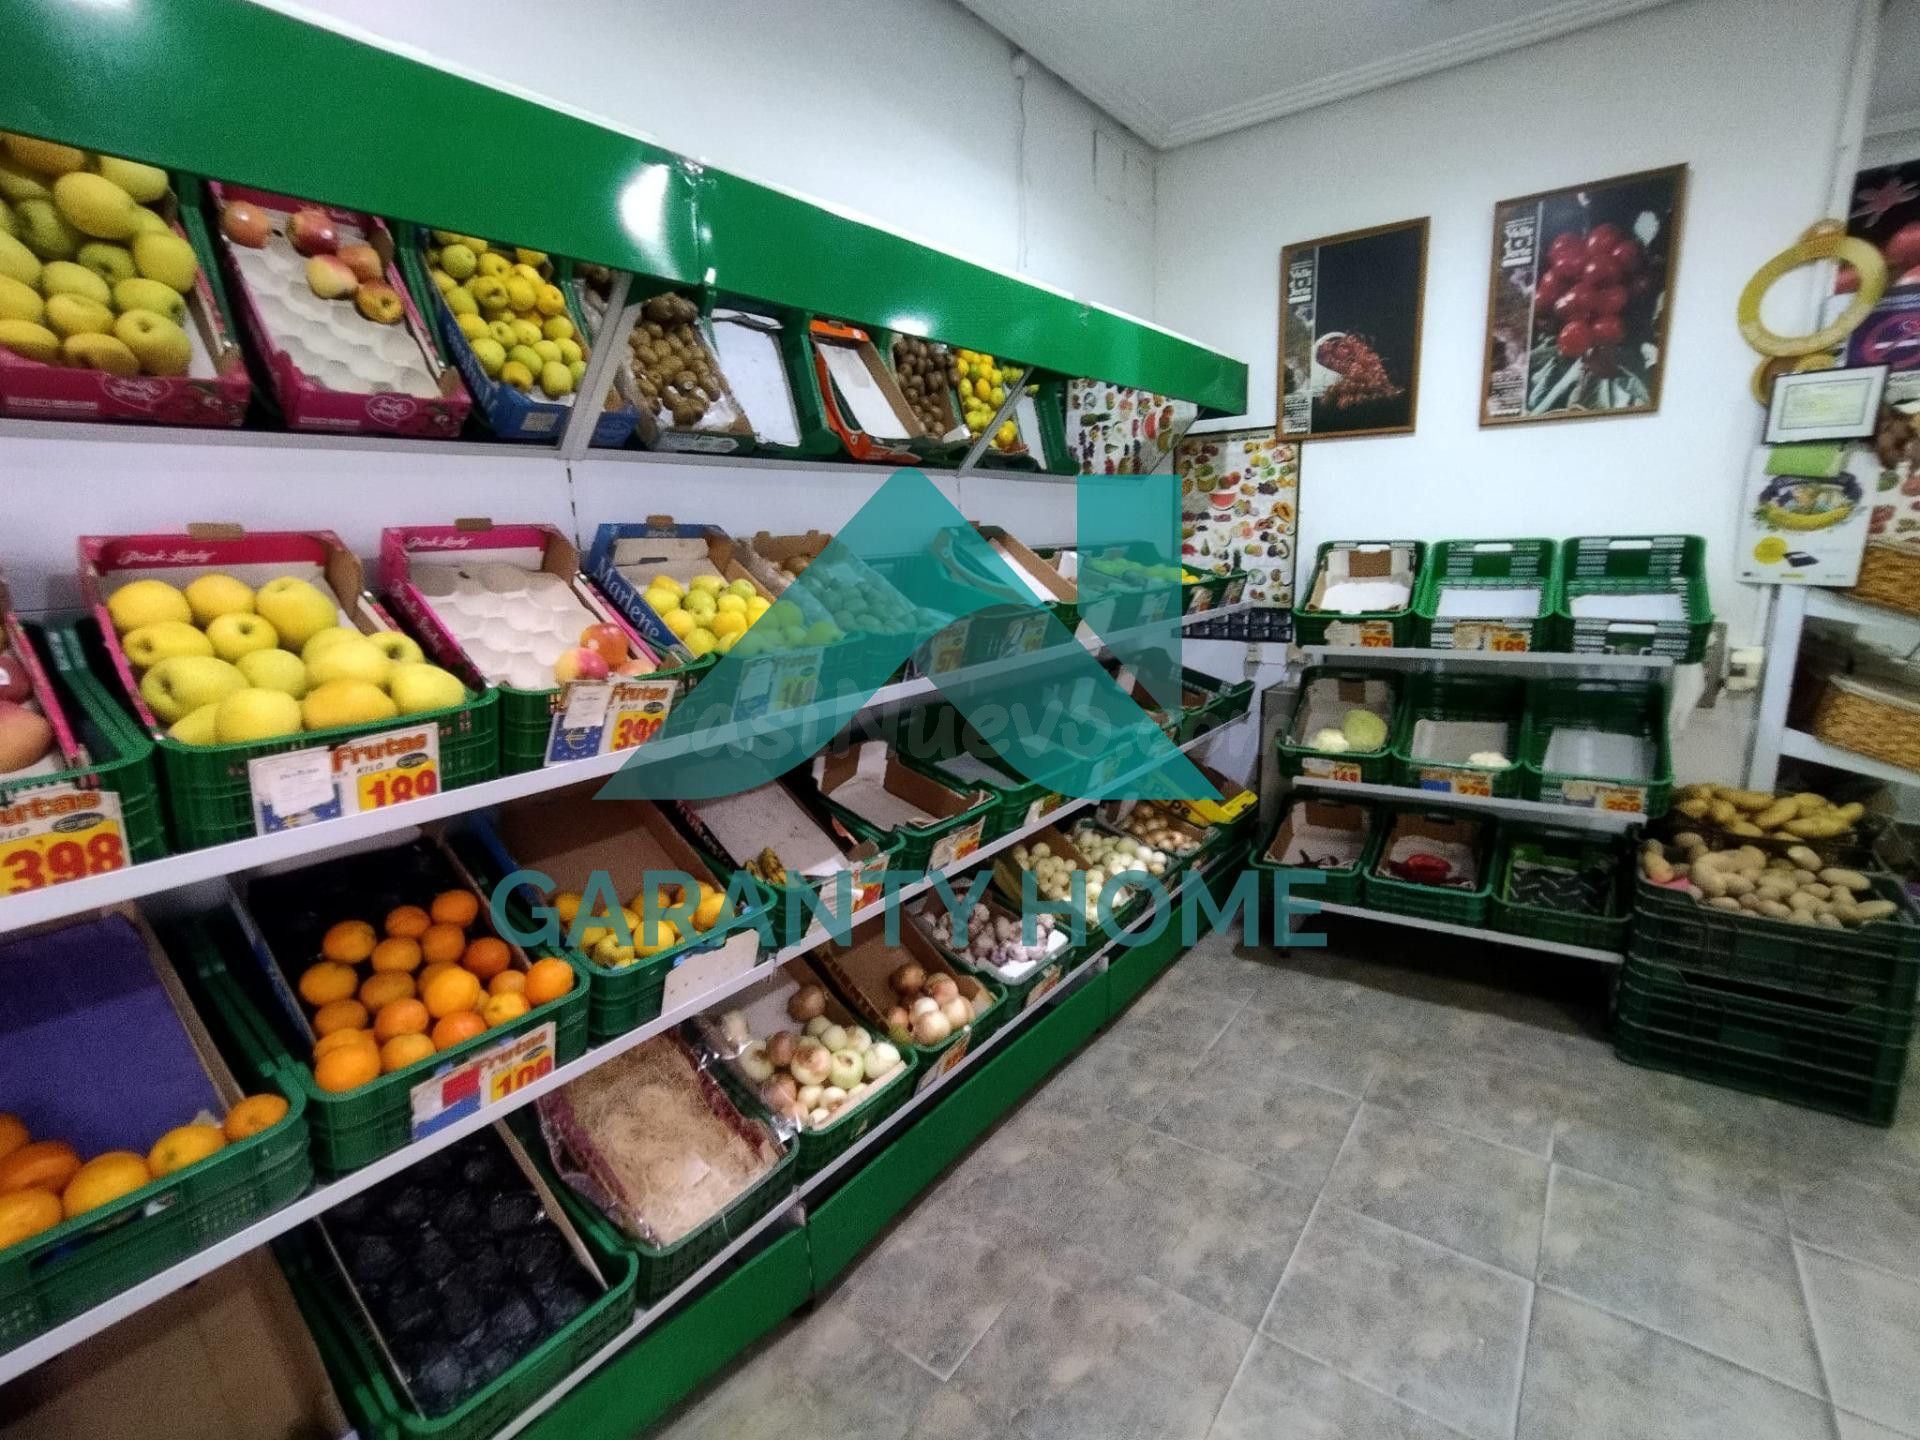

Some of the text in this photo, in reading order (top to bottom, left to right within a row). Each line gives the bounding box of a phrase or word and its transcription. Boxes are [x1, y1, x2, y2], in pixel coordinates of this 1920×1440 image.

[592, 556, 661, 638] Marlene
[332, 733, 428, 774] Frutas
[0, 792, 101, 827] utas
